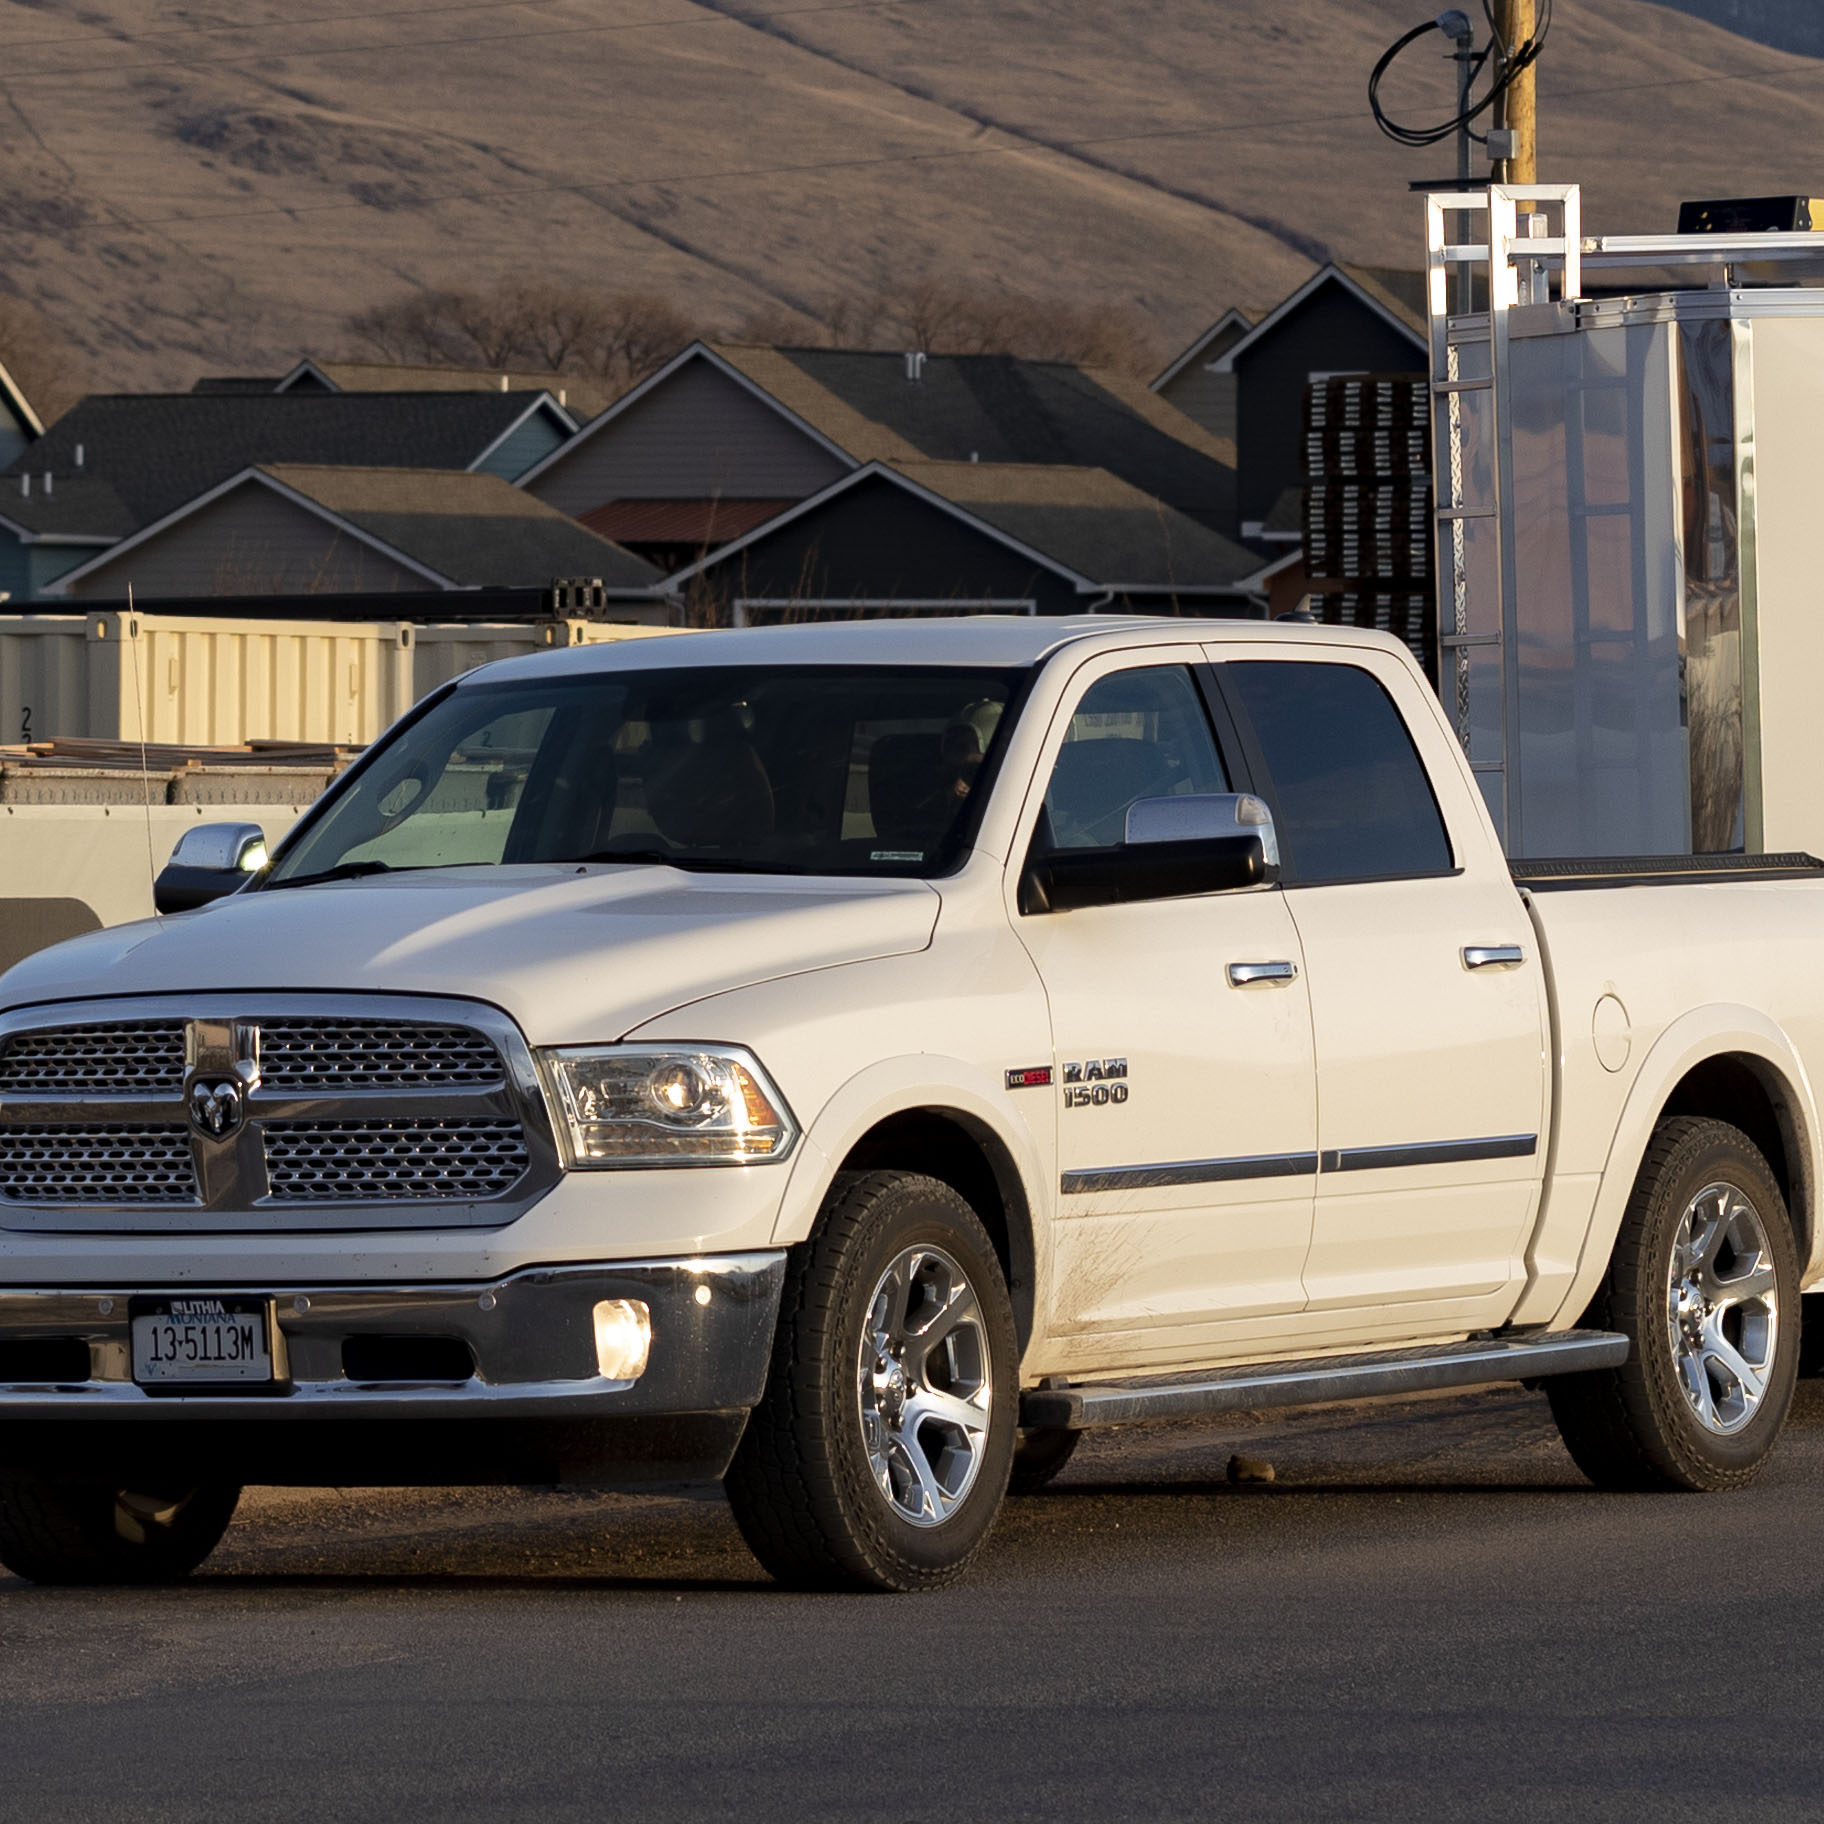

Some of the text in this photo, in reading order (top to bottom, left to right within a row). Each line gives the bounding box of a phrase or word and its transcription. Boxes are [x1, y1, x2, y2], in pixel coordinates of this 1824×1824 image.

[1062, 1057, 1127, 1084] RAM
[1063, 1082, 1129, 1109] 1500
[182, 1300, 226, 1315] LITHIA
